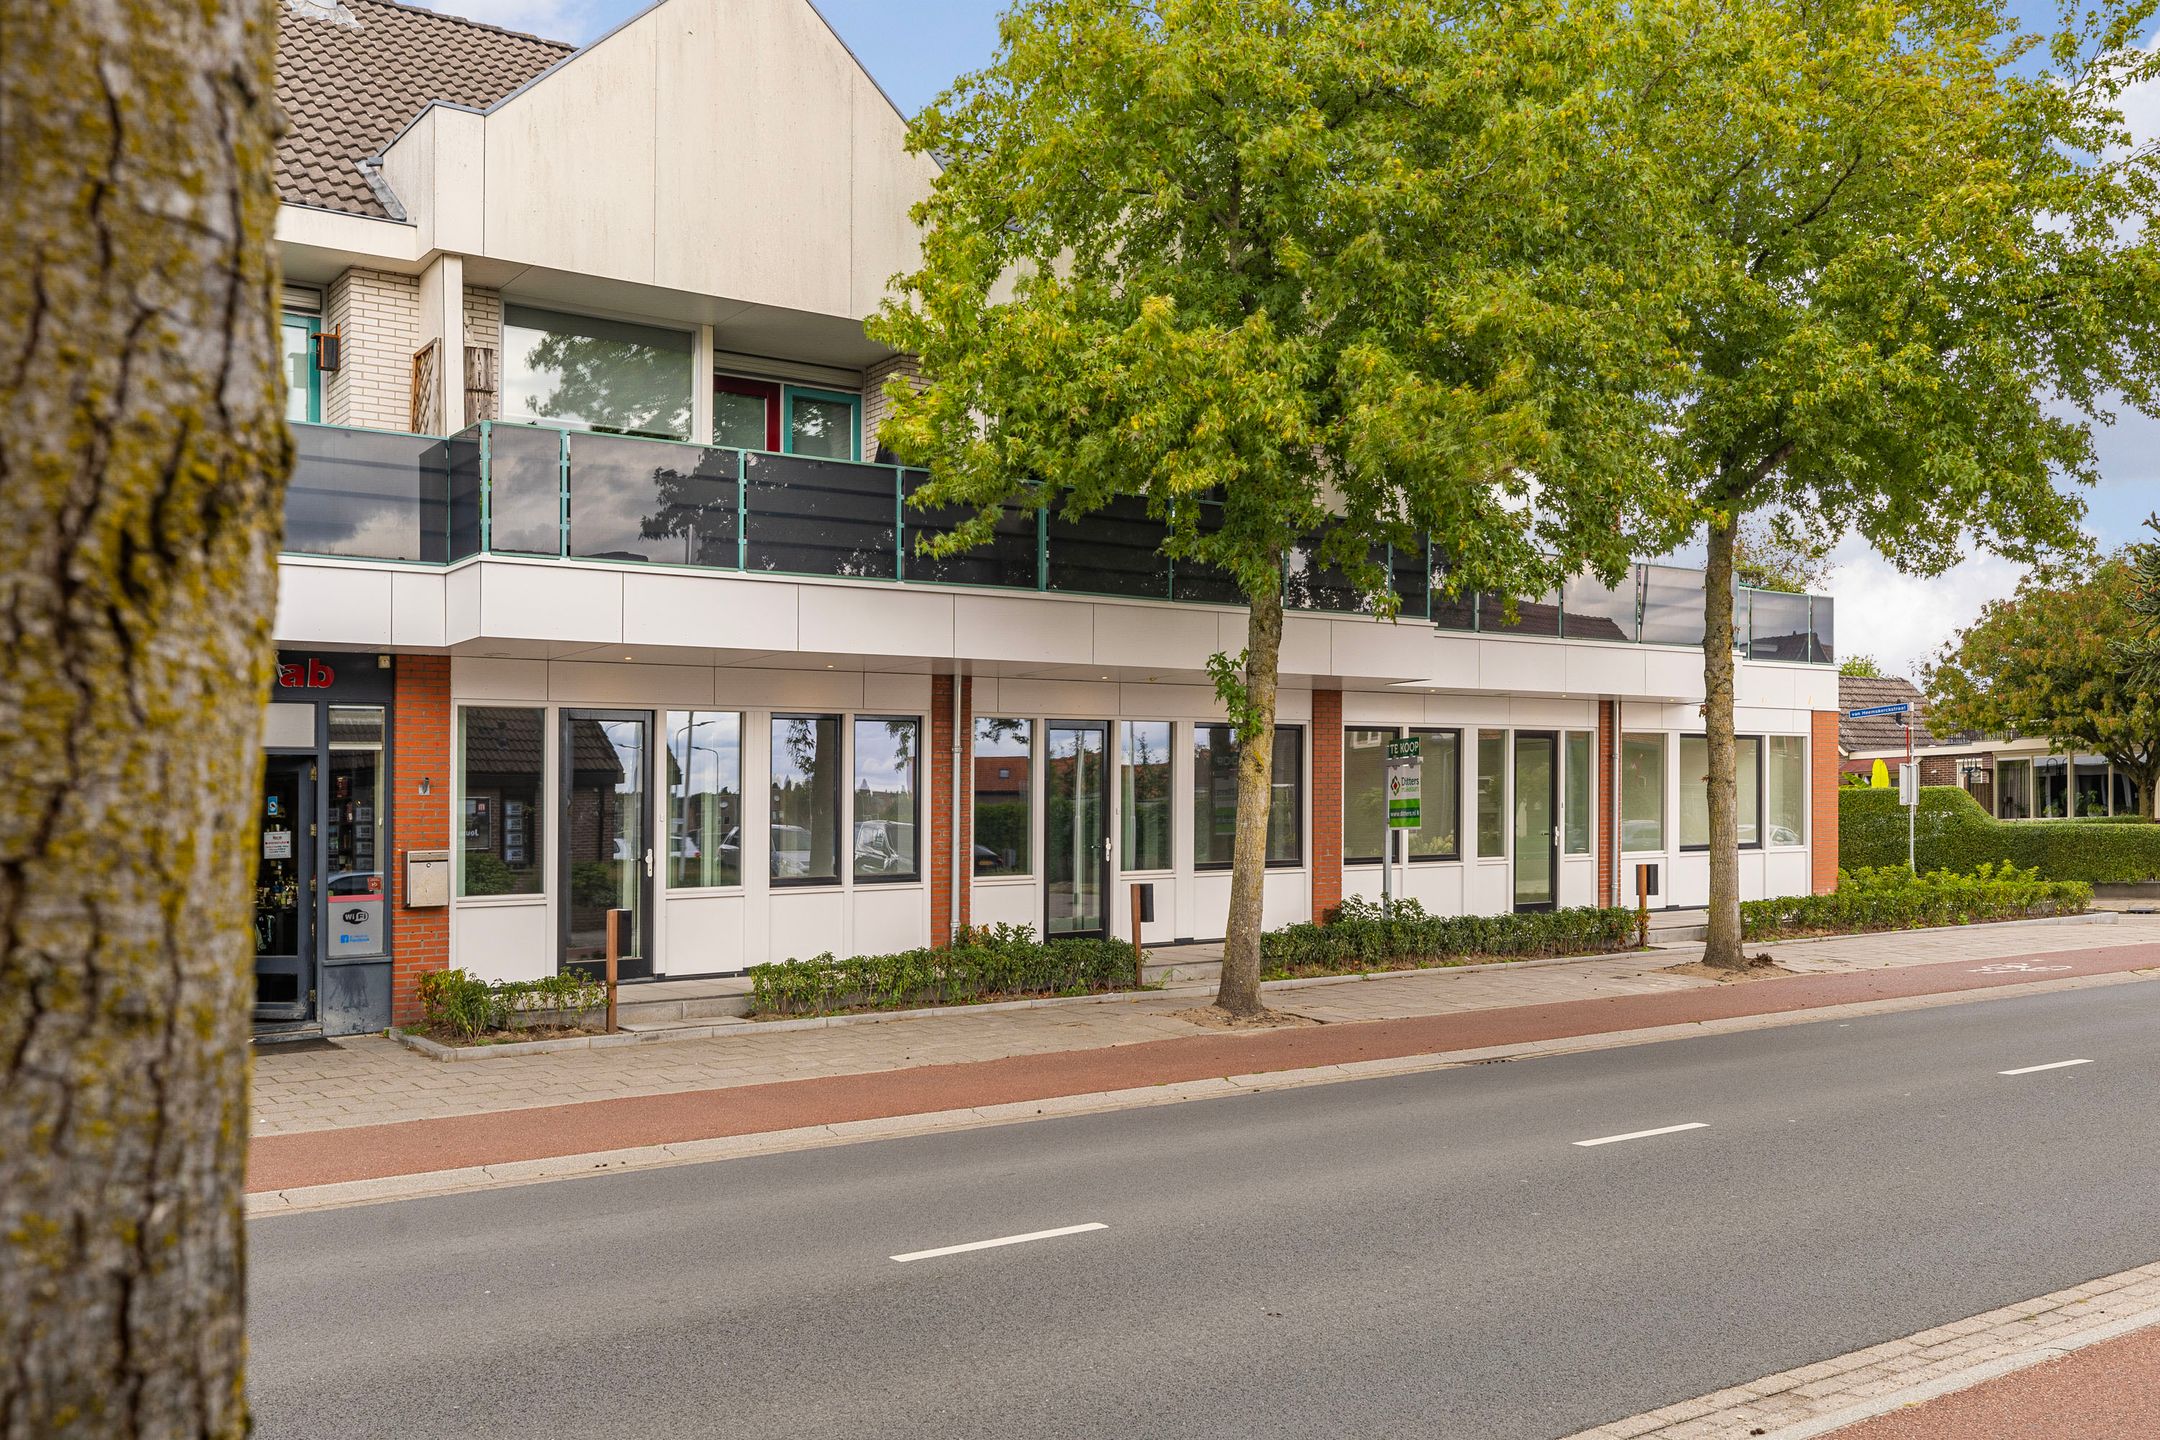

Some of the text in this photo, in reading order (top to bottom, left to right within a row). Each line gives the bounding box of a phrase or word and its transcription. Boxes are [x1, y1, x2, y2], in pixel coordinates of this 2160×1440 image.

[278, 657, 335, 688] ab
[1390, 741, 1419, 754] TE KOOP
[1401, 776, 1419, 786] Ditters
